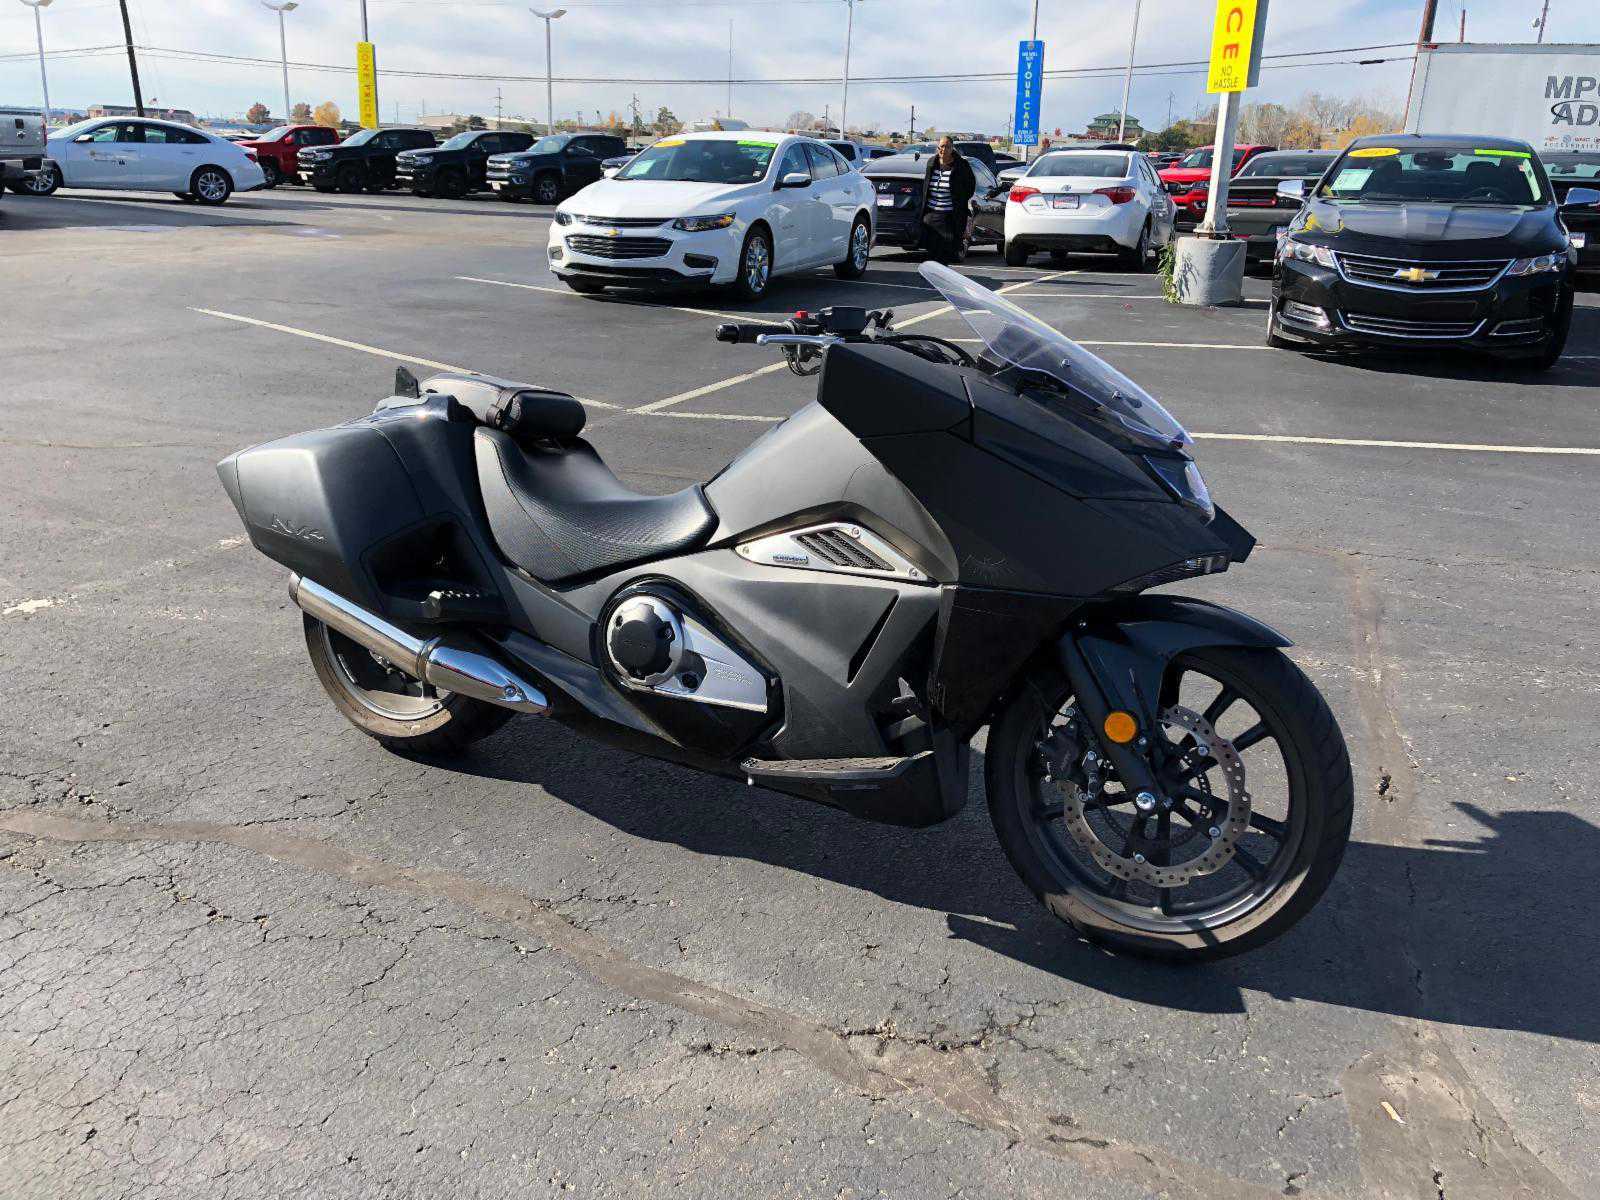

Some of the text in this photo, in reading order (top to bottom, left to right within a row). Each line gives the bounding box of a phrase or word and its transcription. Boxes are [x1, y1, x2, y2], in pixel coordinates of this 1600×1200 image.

[1222, 0, 1244, 60] CE
[1221, 65, 1233, 77] NO
[1213, 77, 1239, 89] HASSLE
[1544, 75, 1600, 99] MP
[1552, 103, 1600, 126] AD
